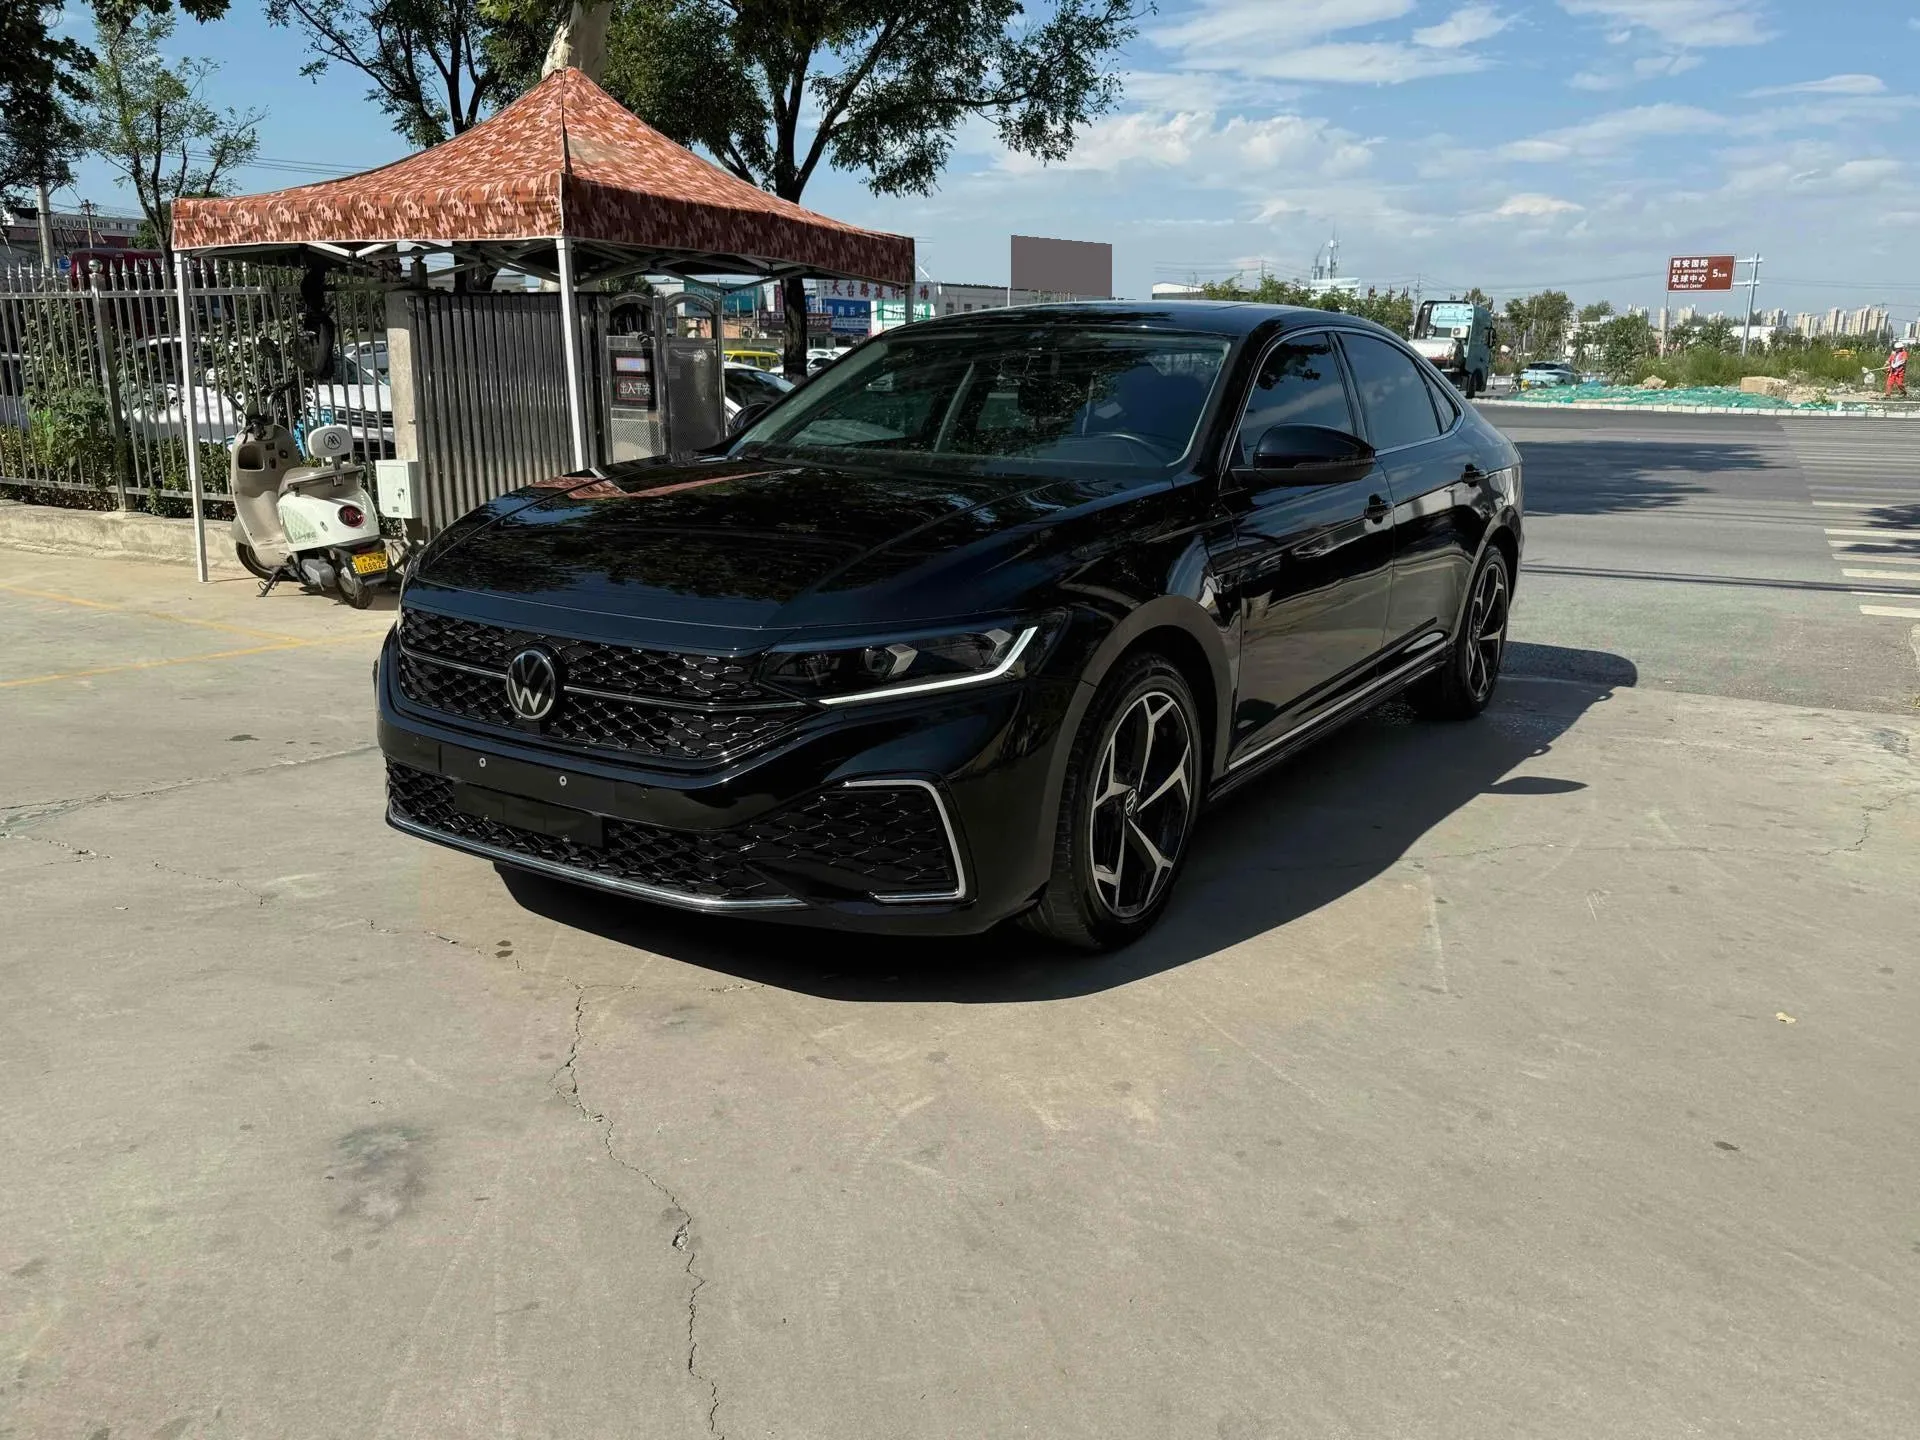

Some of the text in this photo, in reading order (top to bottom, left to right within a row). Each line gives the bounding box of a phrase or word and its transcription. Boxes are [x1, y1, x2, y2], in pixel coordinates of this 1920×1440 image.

[1673, 259, 1708, 268] 西安国际
[1672, 274, 1706, 282] 足球中心
[620, 382, 650, 396] 出入平安
